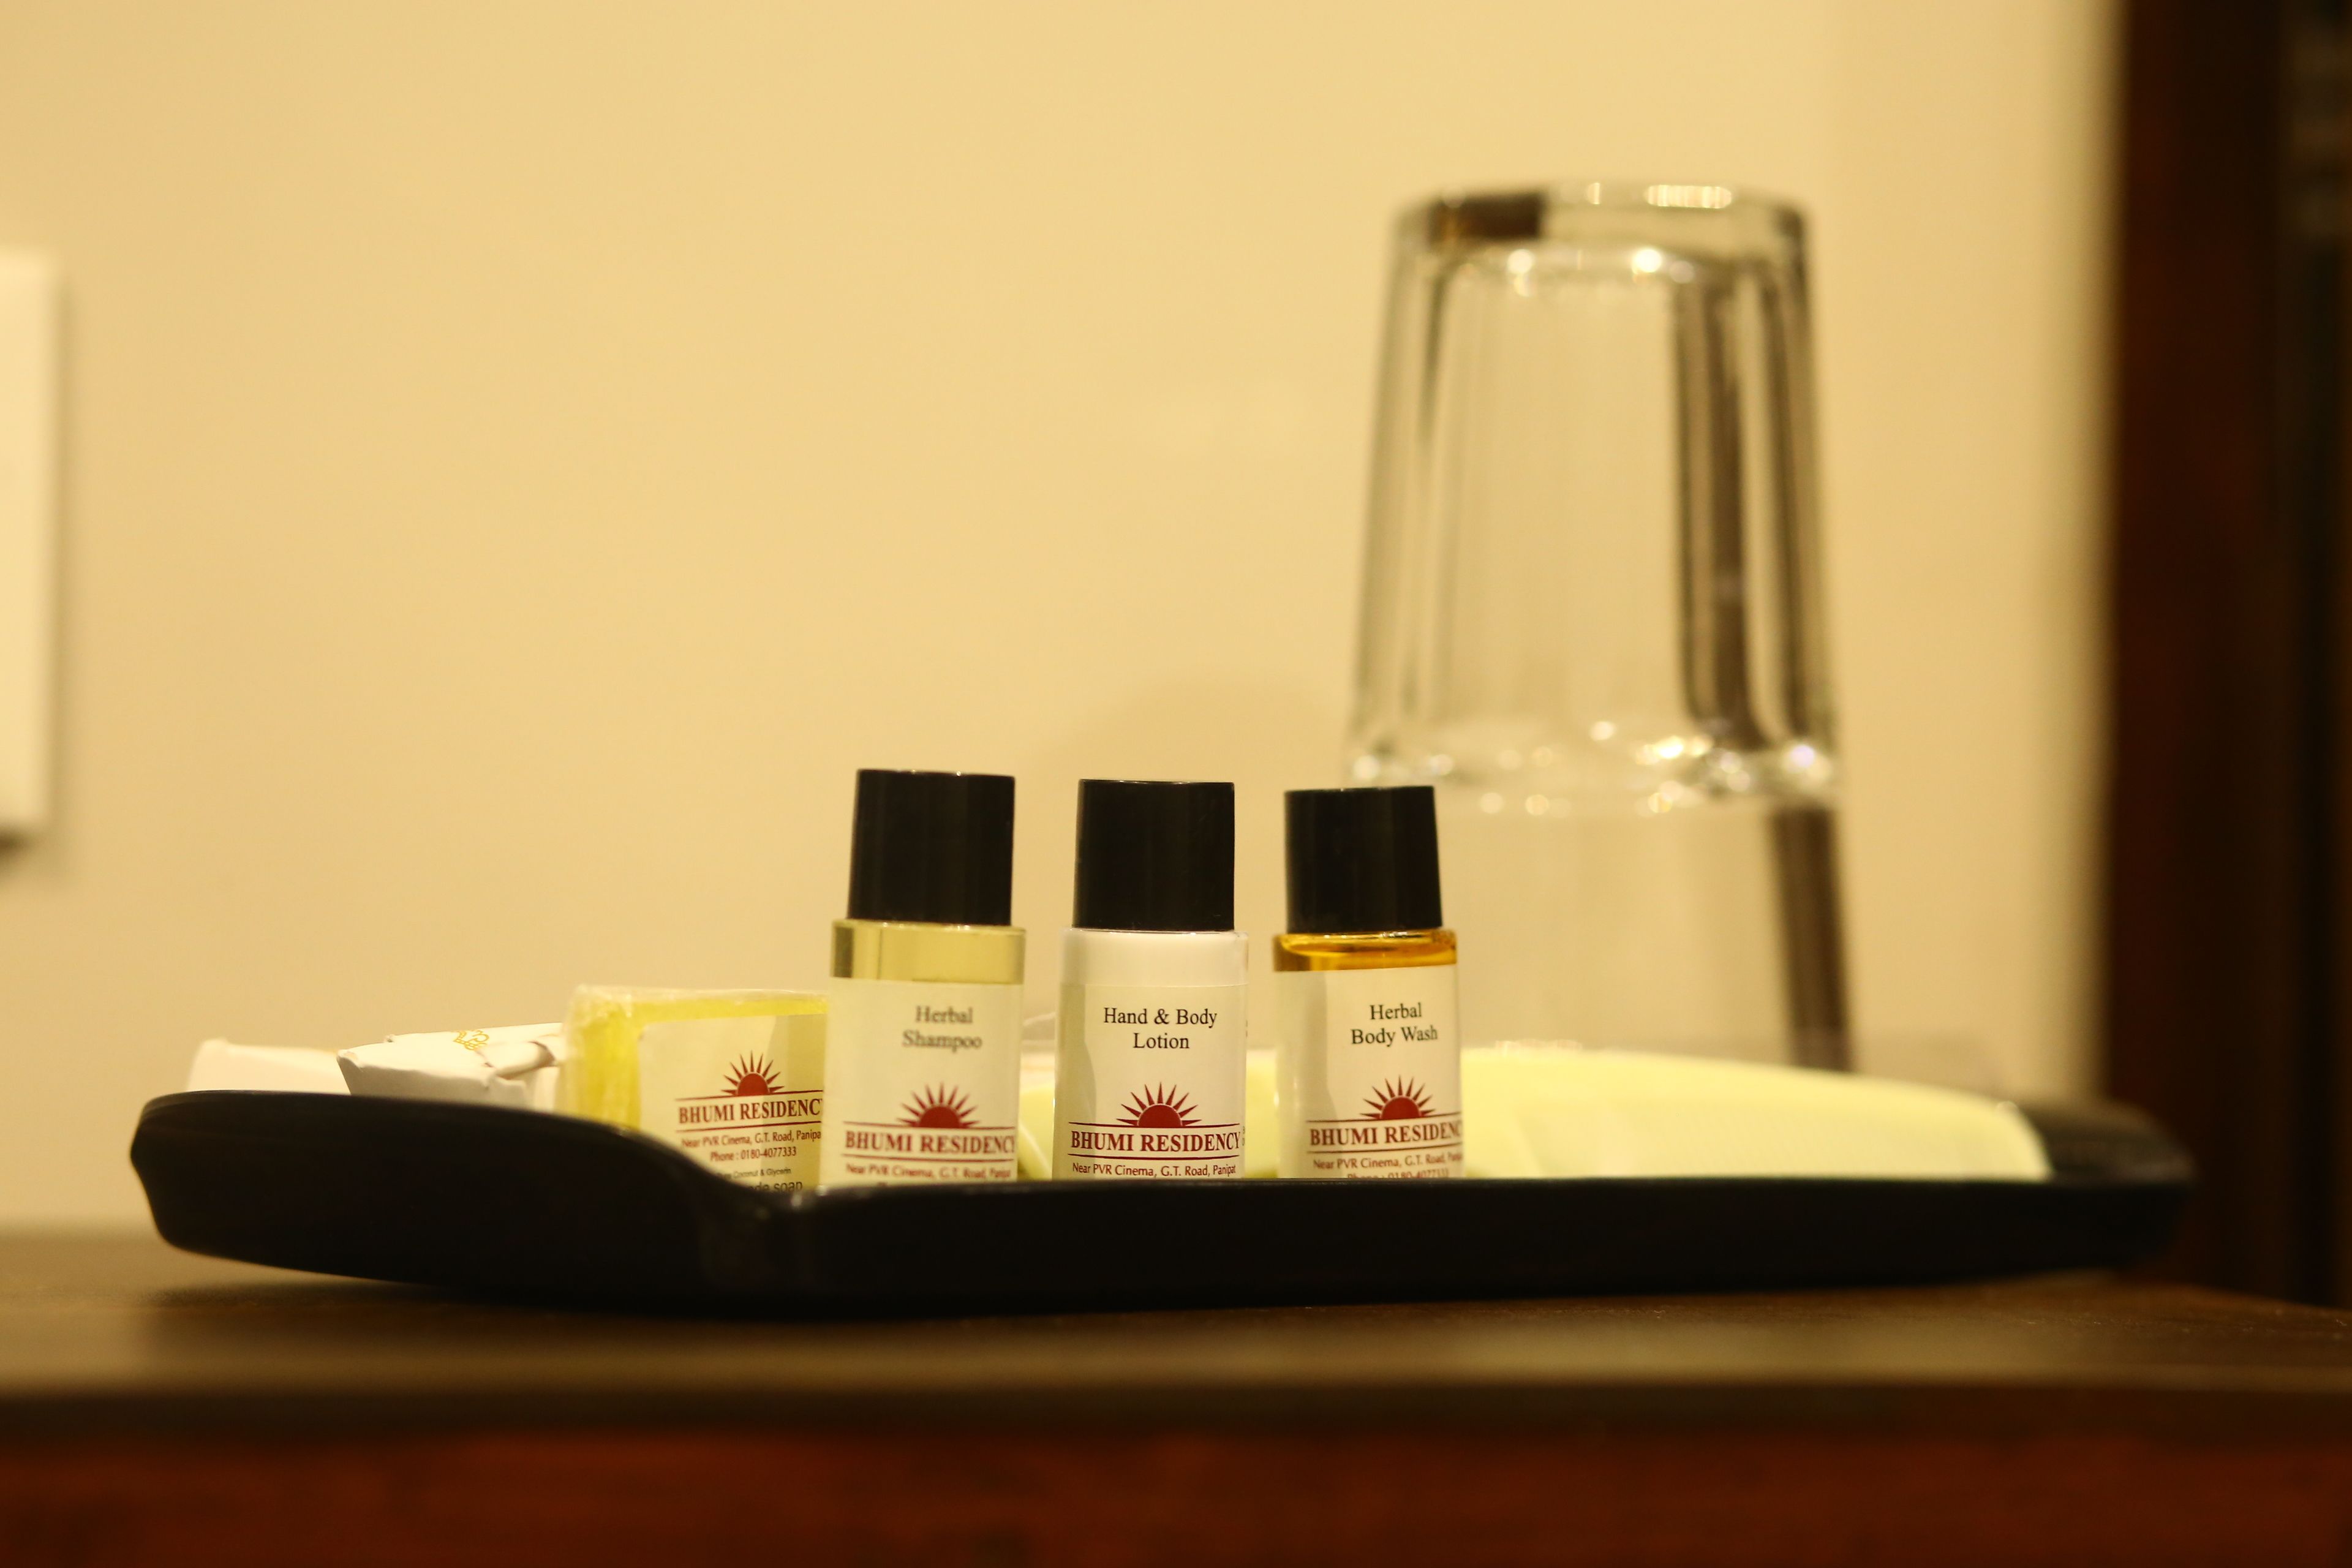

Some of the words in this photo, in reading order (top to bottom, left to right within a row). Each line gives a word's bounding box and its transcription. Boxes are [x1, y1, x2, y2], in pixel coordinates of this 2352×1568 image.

[916, 1006, 973, 1023] Herbal
[1104, 1008, 1148, 1024] Hand
[1154, 1009, 1170, 1024] &
[1175, 1009, 1218, 1028] Body
[1370, 1002, 1422, 1020] Herbal
[902, 1030, 982, 1053] Shampoo
[1133, 1033, 1189, 1049] Lotion
[1351, 1028, 1396, 1047] Body
[1401, 1025, 1438, 1041] Wash
[679, 1104, 735, 1124] BHUMI
[740, 1098, 823, 1120] RESIDENC
[703, 1136, 720, 1146] PVR
[755, 1132, 770, 1144] G.T.
[773, 1131, 794, 1142] Road,
[796, 1129, 821, 1142] Panipa
[845, 1131, 913, 1152] BHUMI
[1071, 1130, 1134, 1151] BHUMI
[1140, 1132, 1240, 1152] RESIDENCY
[1310, 1127, 1378, 1146] BHUMI
[711, 1152, 734, 1161] Phone
[741, 1146, 796, 1159] 0180-4077333
[1314, 1159, 1333, 1169] Near
[1337, 1158, 1358, 1169] PVR
[1360, 1157, 1401, 1169] Cinema,
[1404, 1155, 1423, 1165] G.T.
[1072, 1163, 1091, 1174] Near
[1093, 1164, 1112, 1175] PVR
[1115, 1164, 1157, 1178] Cinema,
[1161, 1166, 1182, 1177] G.T.
[1185, 1164, 1210, 1177] Road,
[1213, 1164, 1236, 1177] Panipat
